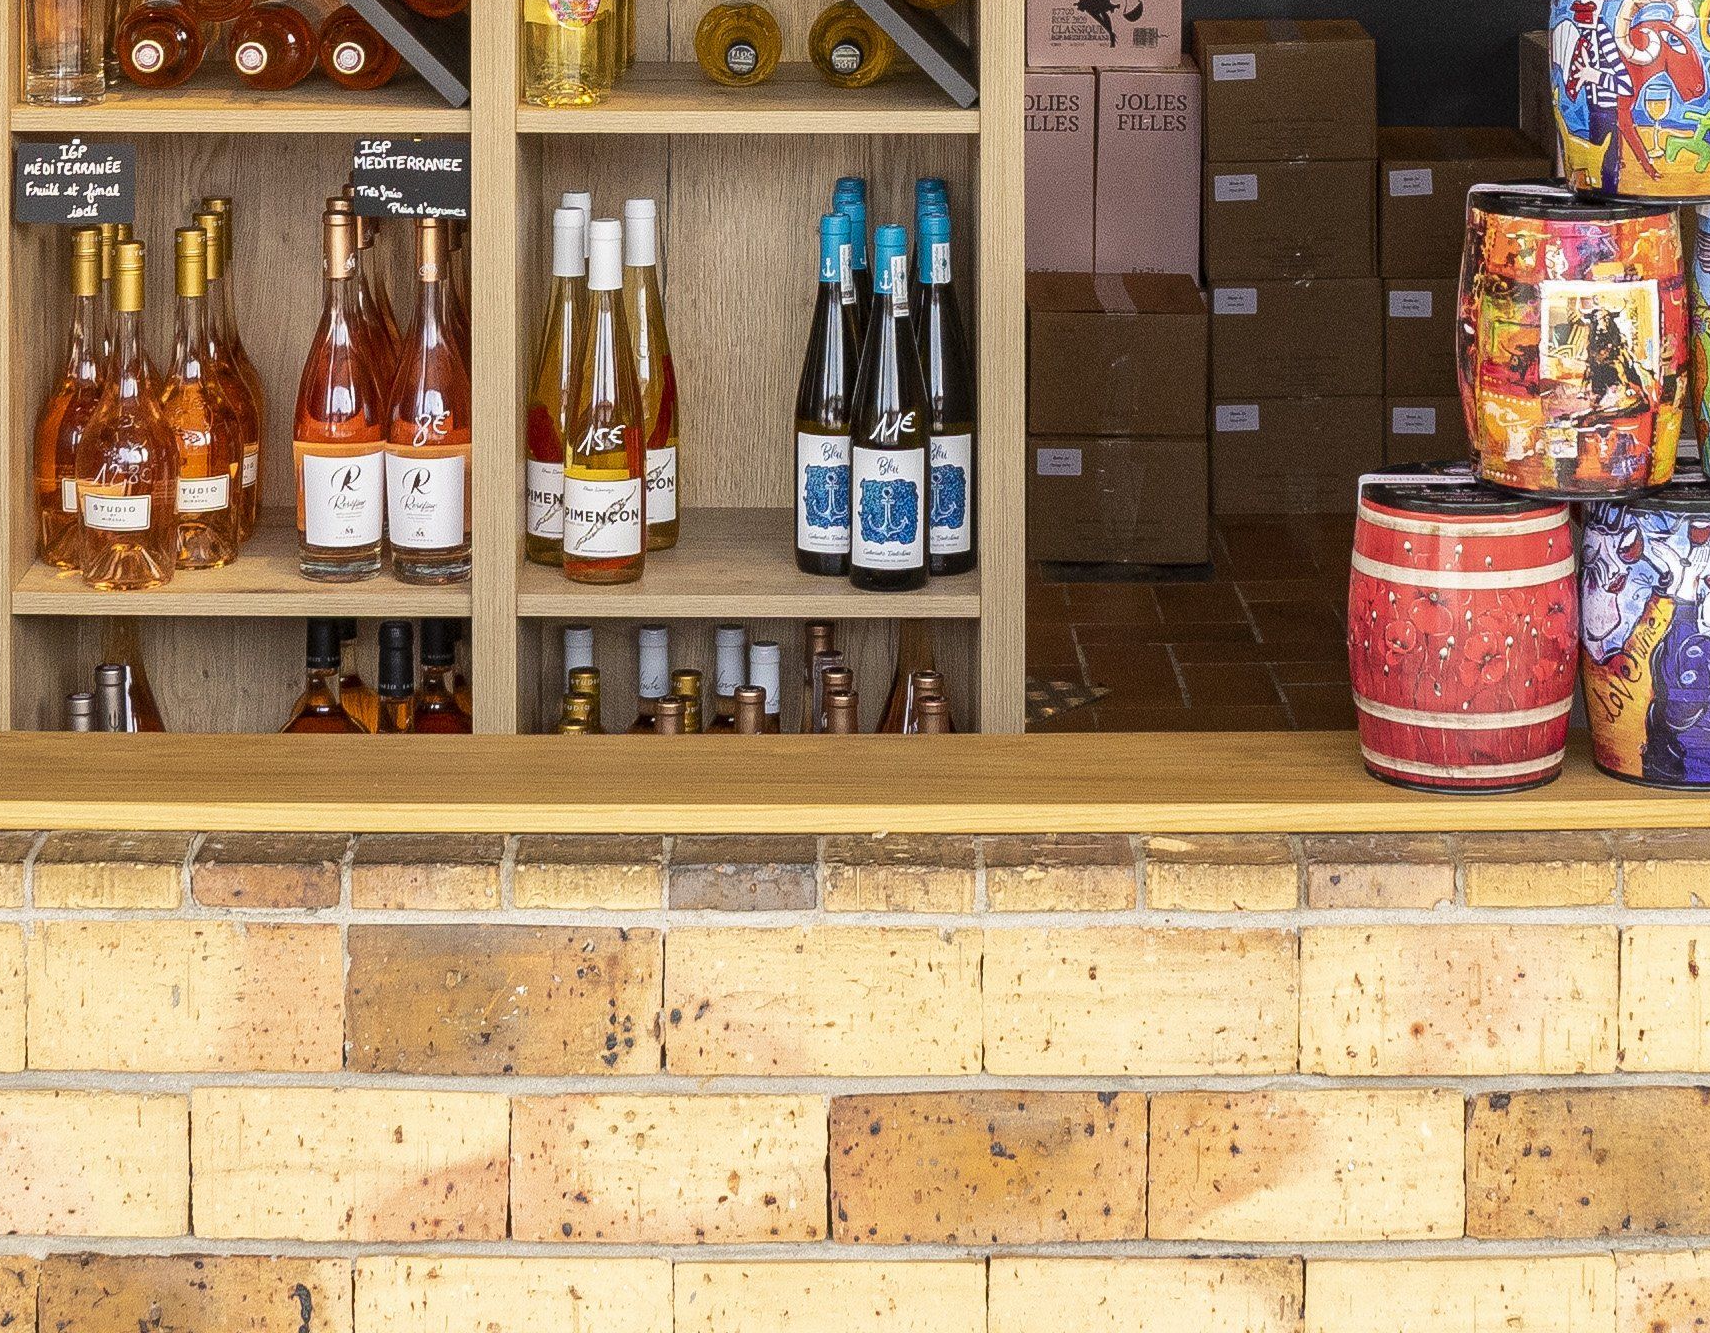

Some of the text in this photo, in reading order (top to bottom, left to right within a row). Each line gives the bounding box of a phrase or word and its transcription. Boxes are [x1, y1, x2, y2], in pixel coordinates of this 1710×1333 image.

[1115, 93, 1188, 112] JOLIES
[1116, 113, 1188, 132] FILLES
[58, 144, 88, 160] IGP
[360, 140, 392, 154] IGP
[25, 181, 121, 204] Fruité et final
[868, 411, 917, 443] 11€
[576, 424, 627, 457] 15€
[92, 503, 137, 514] STUDIO
[565, 506, 640, 525] PIMENÇON
